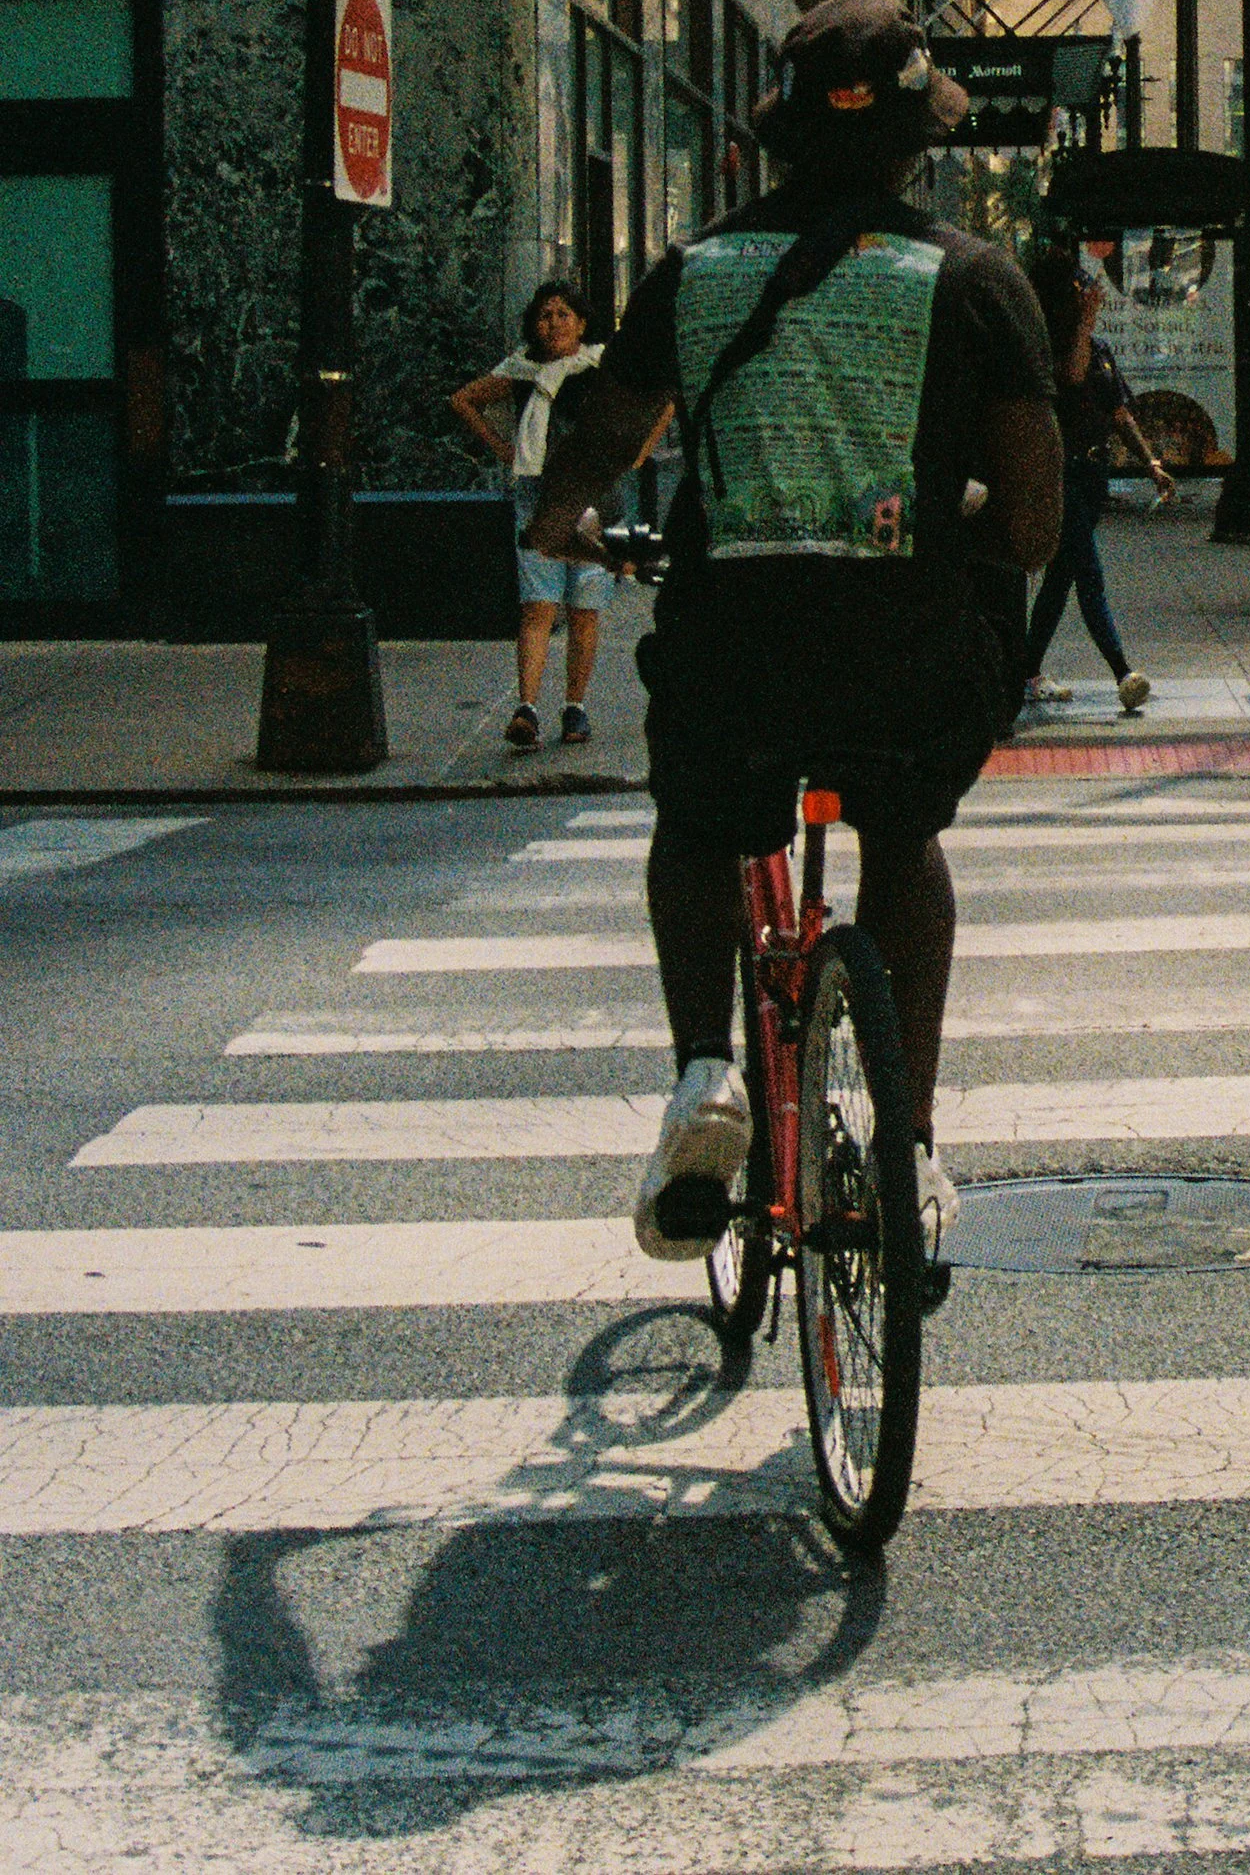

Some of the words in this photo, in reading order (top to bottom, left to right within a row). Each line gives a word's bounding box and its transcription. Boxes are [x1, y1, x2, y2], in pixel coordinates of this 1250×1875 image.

[344, 24, 359, 58] DO
[363, 30, 384, 64] NOT
[967, 64, 1023, 78] Marriott
[349, 123, 380, 158] ENTER
